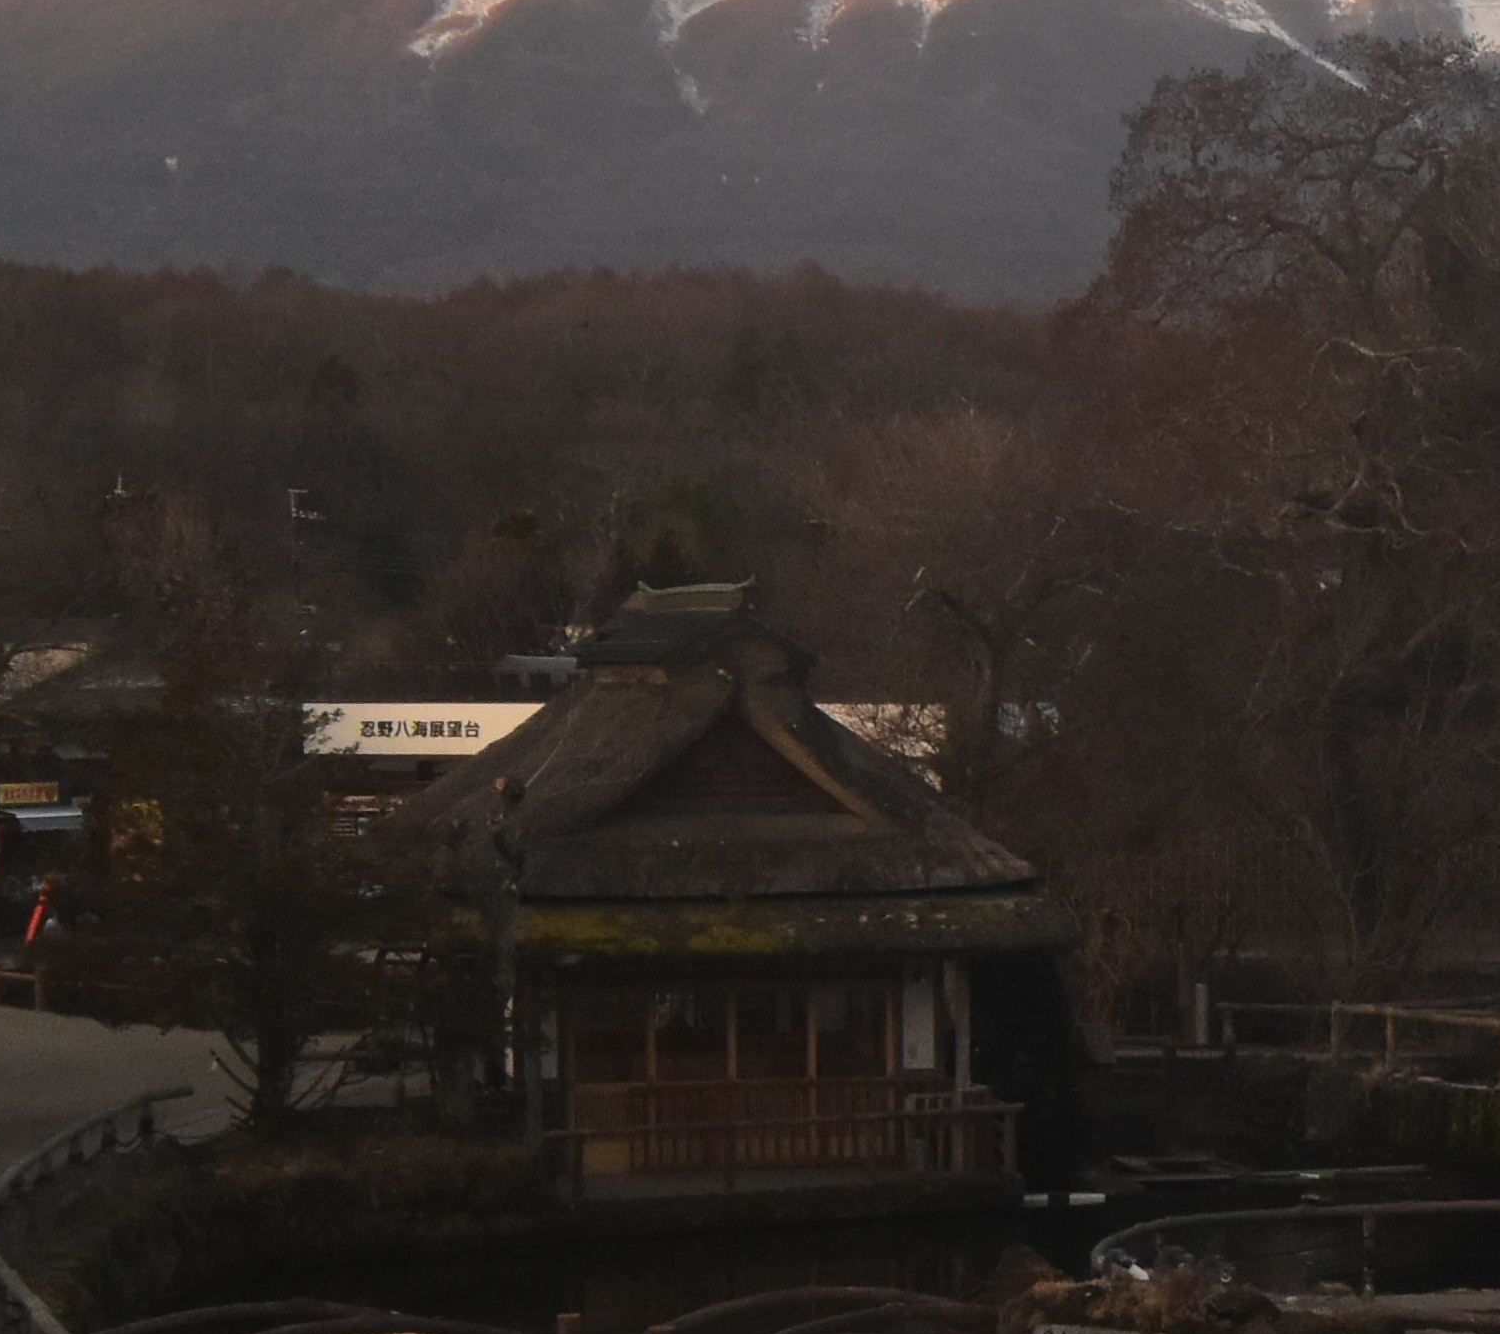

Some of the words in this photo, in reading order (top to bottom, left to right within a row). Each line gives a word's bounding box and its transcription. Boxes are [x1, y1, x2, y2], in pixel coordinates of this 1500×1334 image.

[360, 720, 480, 738] 忍野八海展望台
